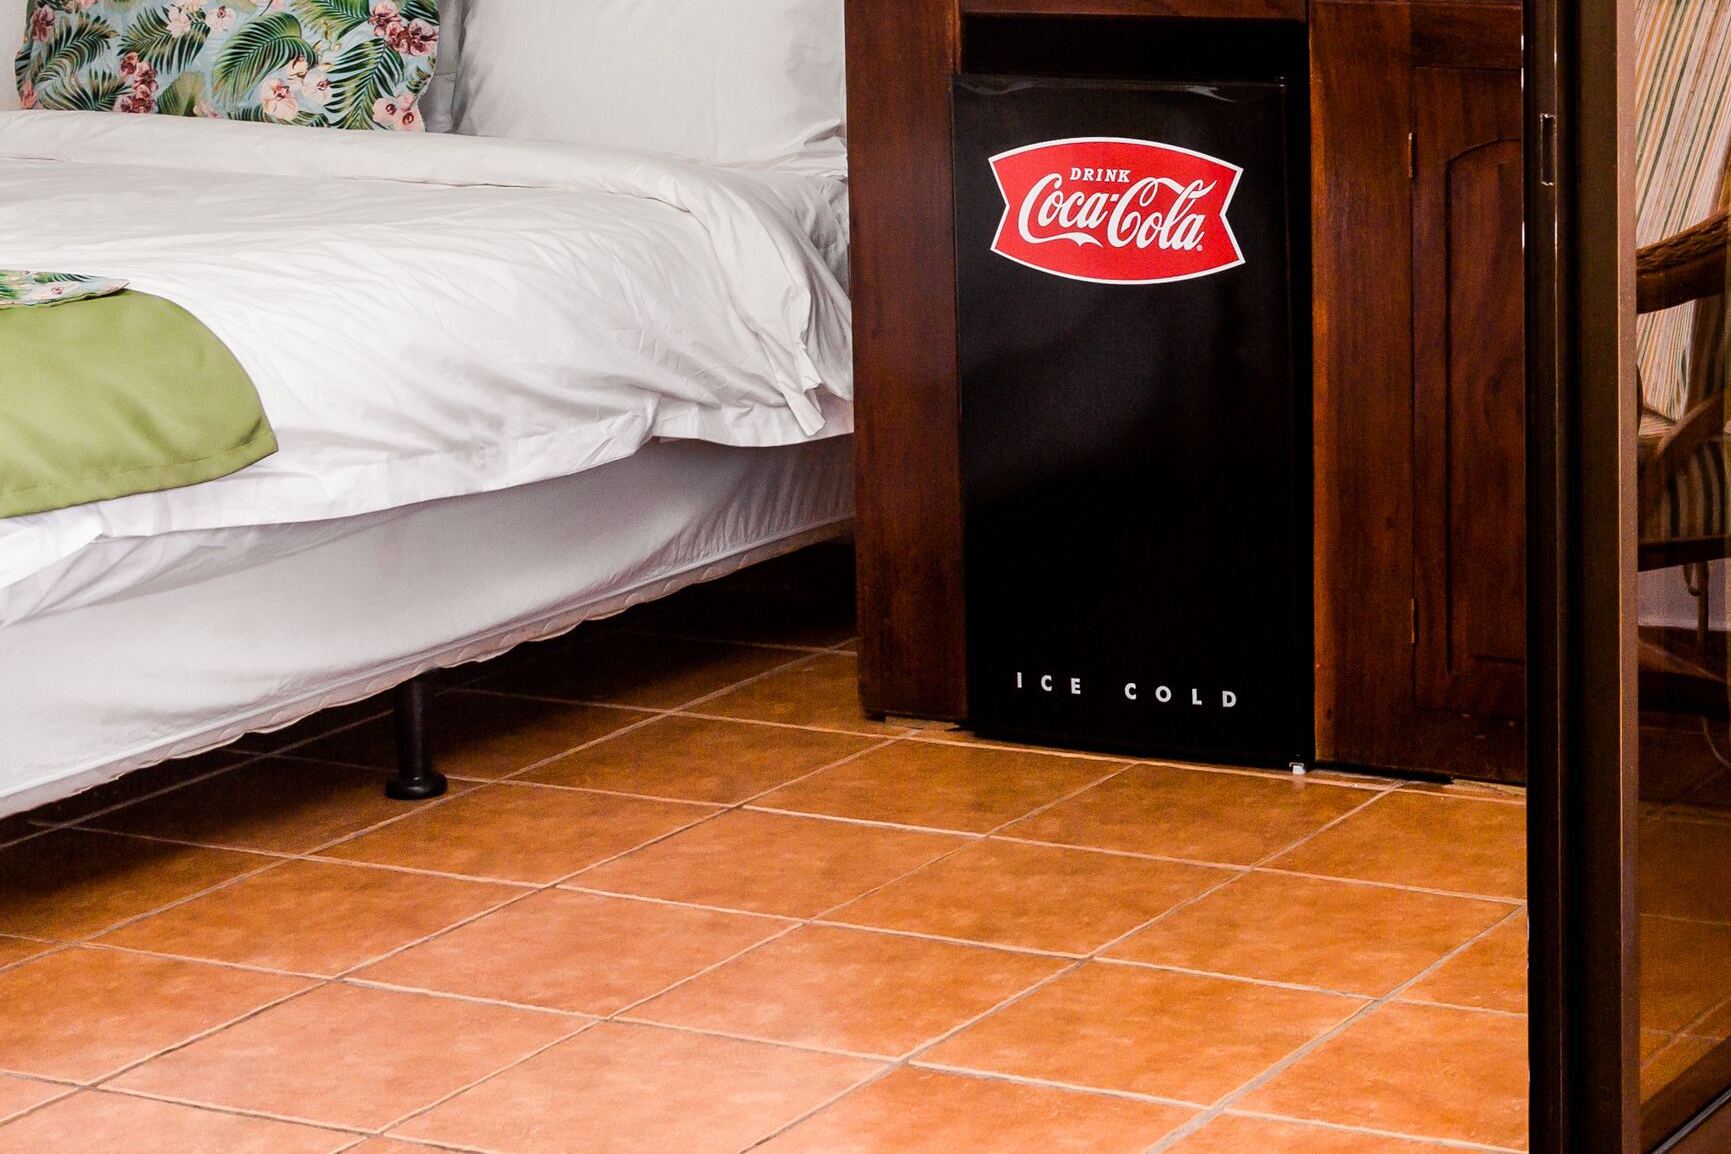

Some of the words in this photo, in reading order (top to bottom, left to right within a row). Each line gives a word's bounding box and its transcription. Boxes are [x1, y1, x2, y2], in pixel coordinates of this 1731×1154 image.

[1069, 167, 1131, 183] DRINK
[1017, 172, 1218, 251] Coca-Cola
[1016, 671, 1081, 695] ICE
[1124, 682, 1237, 708] COLD
